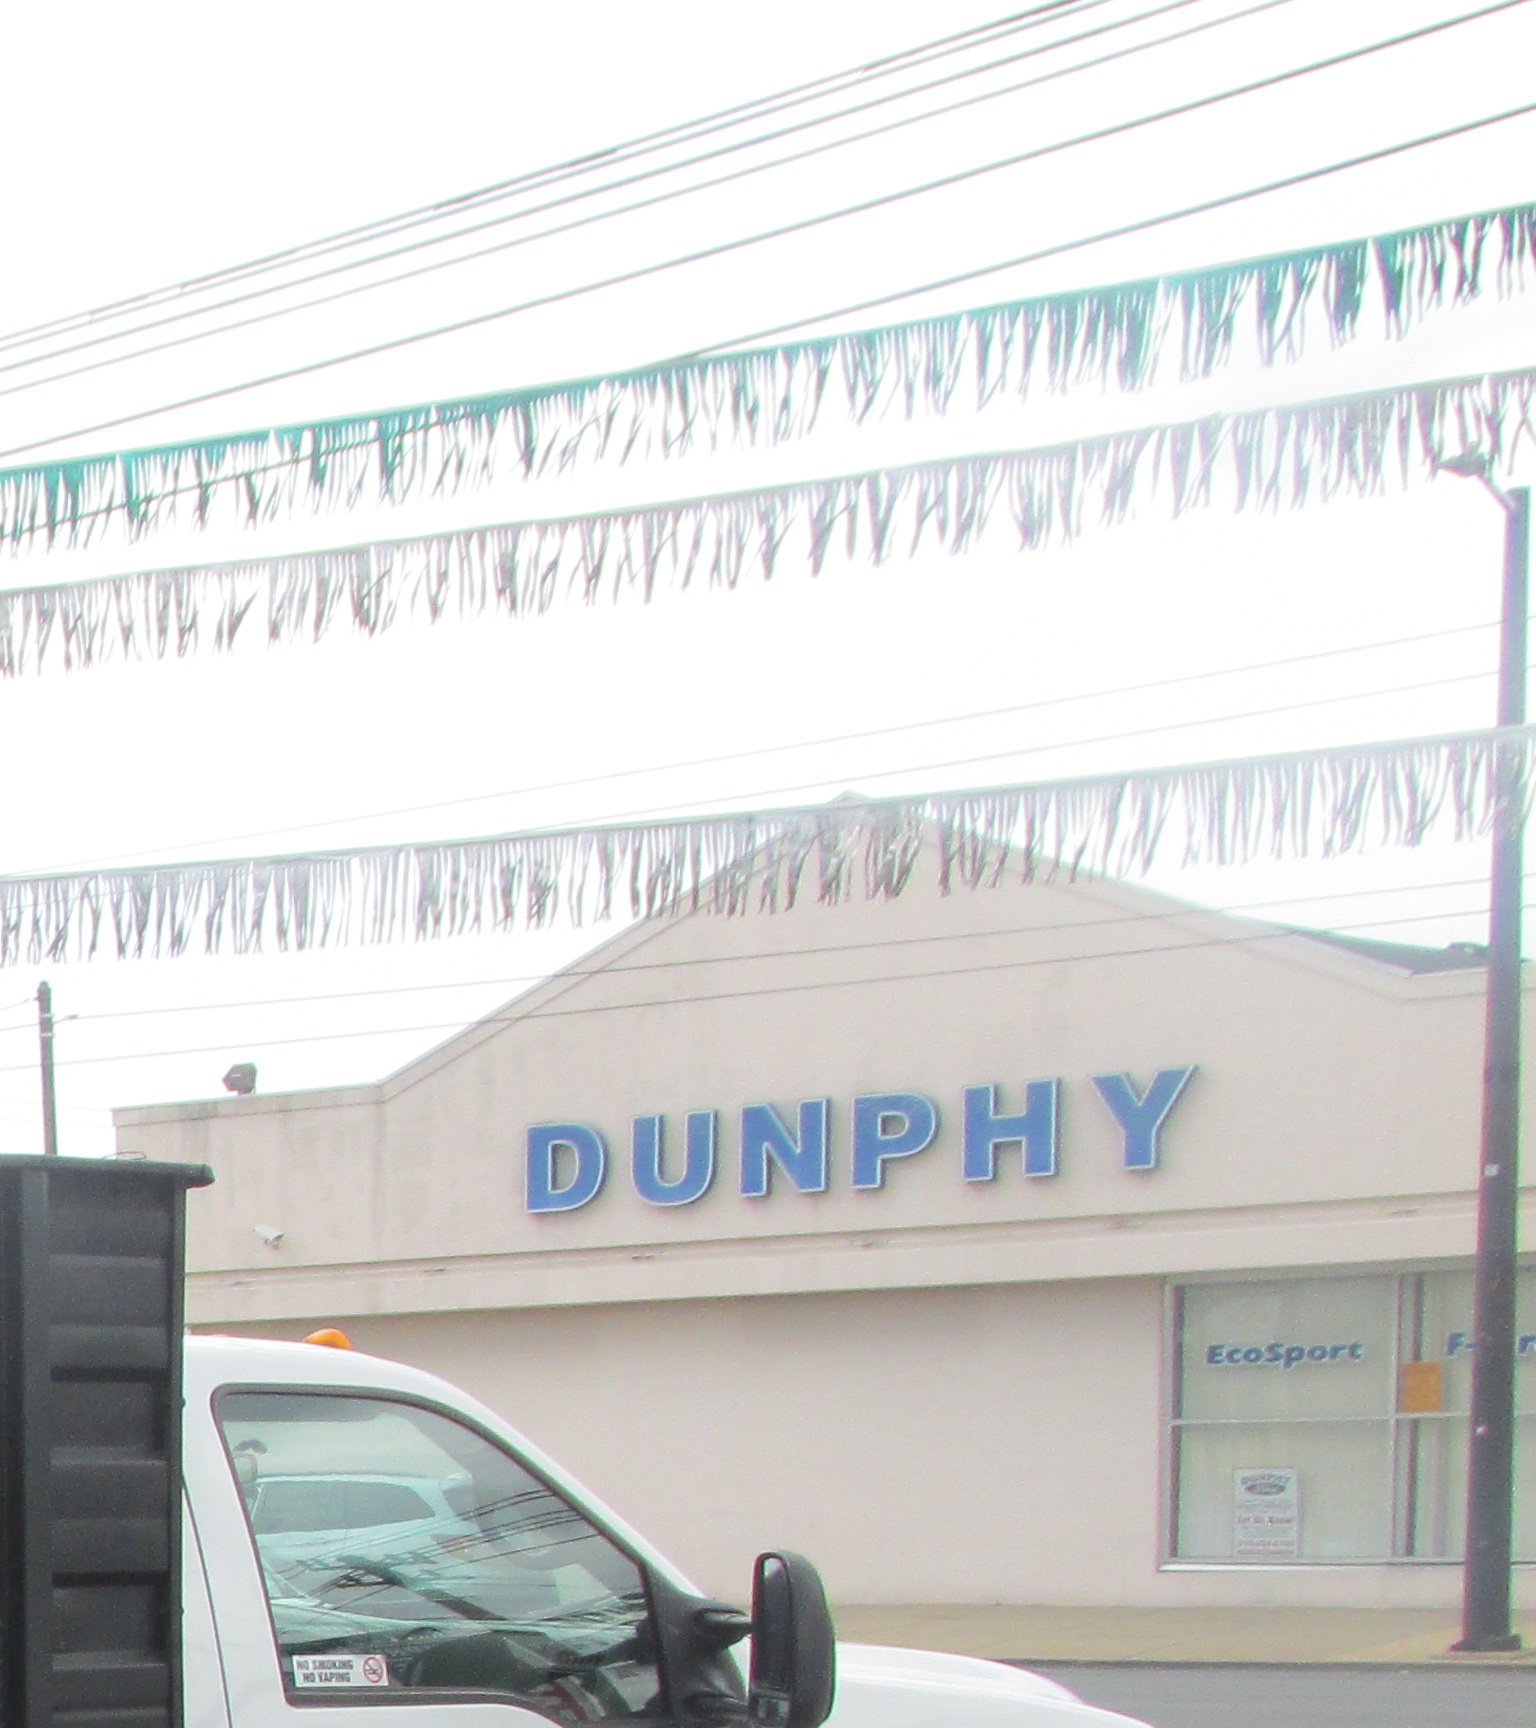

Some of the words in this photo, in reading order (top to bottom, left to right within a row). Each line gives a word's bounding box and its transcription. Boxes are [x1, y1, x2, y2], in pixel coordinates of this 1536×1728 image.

[525, 1064, 1199, 1214] DUNPHY
[1206, 1340, 1364, 1369] EcoSport
[296, 1660, 310, 1670] NO
[312, 1659, 354, 1670] SMOKING
[303, 1672, 316, 1683] NO
[317, 1672, 351, 1683] VAPING
